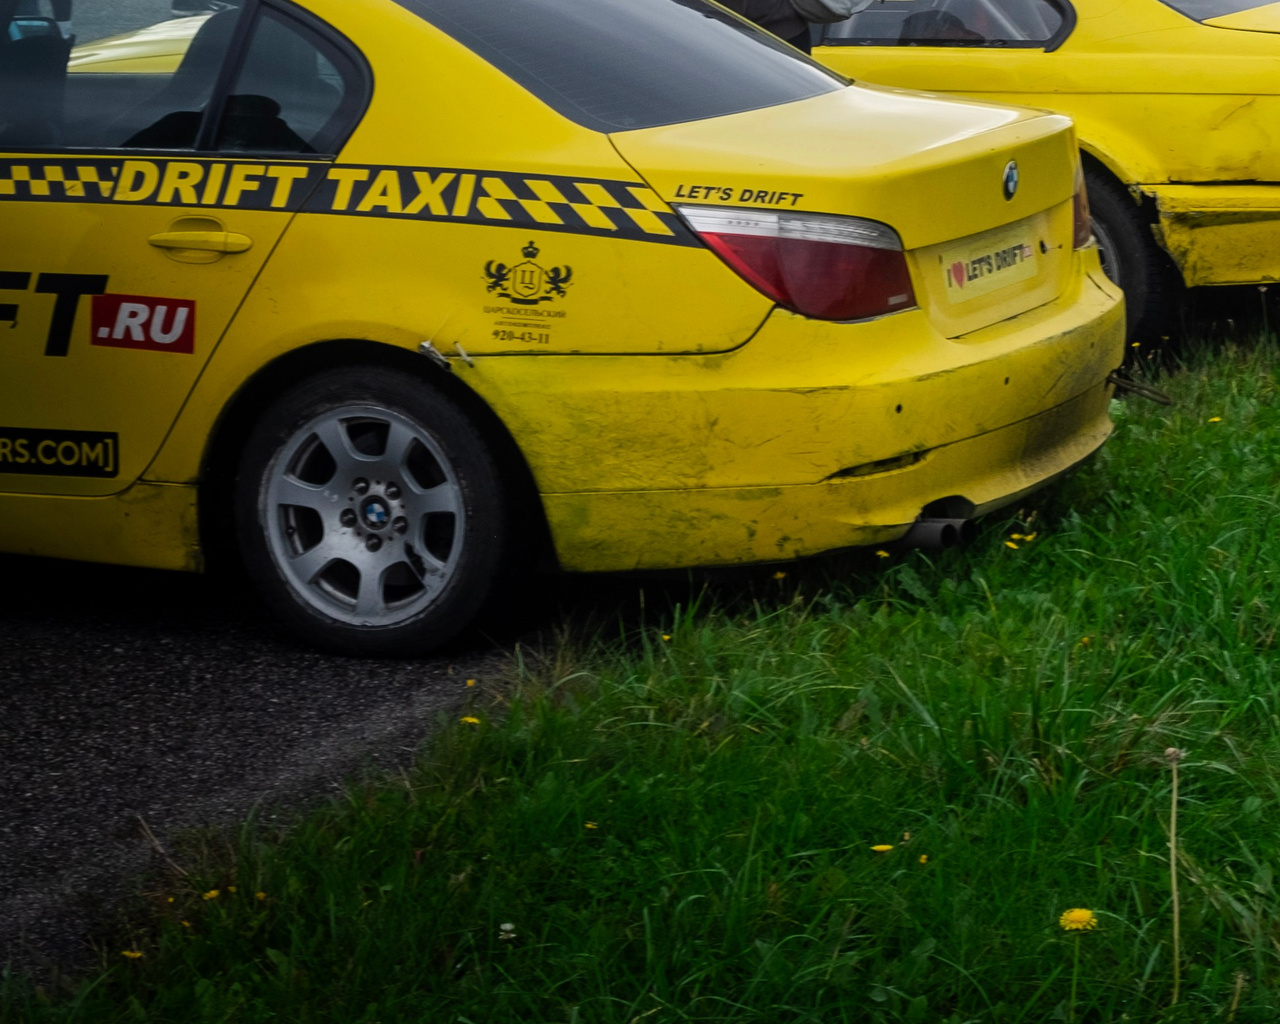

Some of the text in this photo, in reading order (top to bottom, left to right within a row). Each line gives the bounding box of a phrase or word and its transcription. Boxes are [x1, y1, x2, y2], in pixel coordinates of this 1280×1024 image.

[112, 160, 477, 217] DRIFT TAXI
[675, 184, 804, 206] LET'S DRIFT
[965, 254, 993, 282] LET'S
[994, 243, 1024, 271] DRIFT
[97, 302, 189, 344] .RU
[492, 329, 550, 345] 920-43-11
